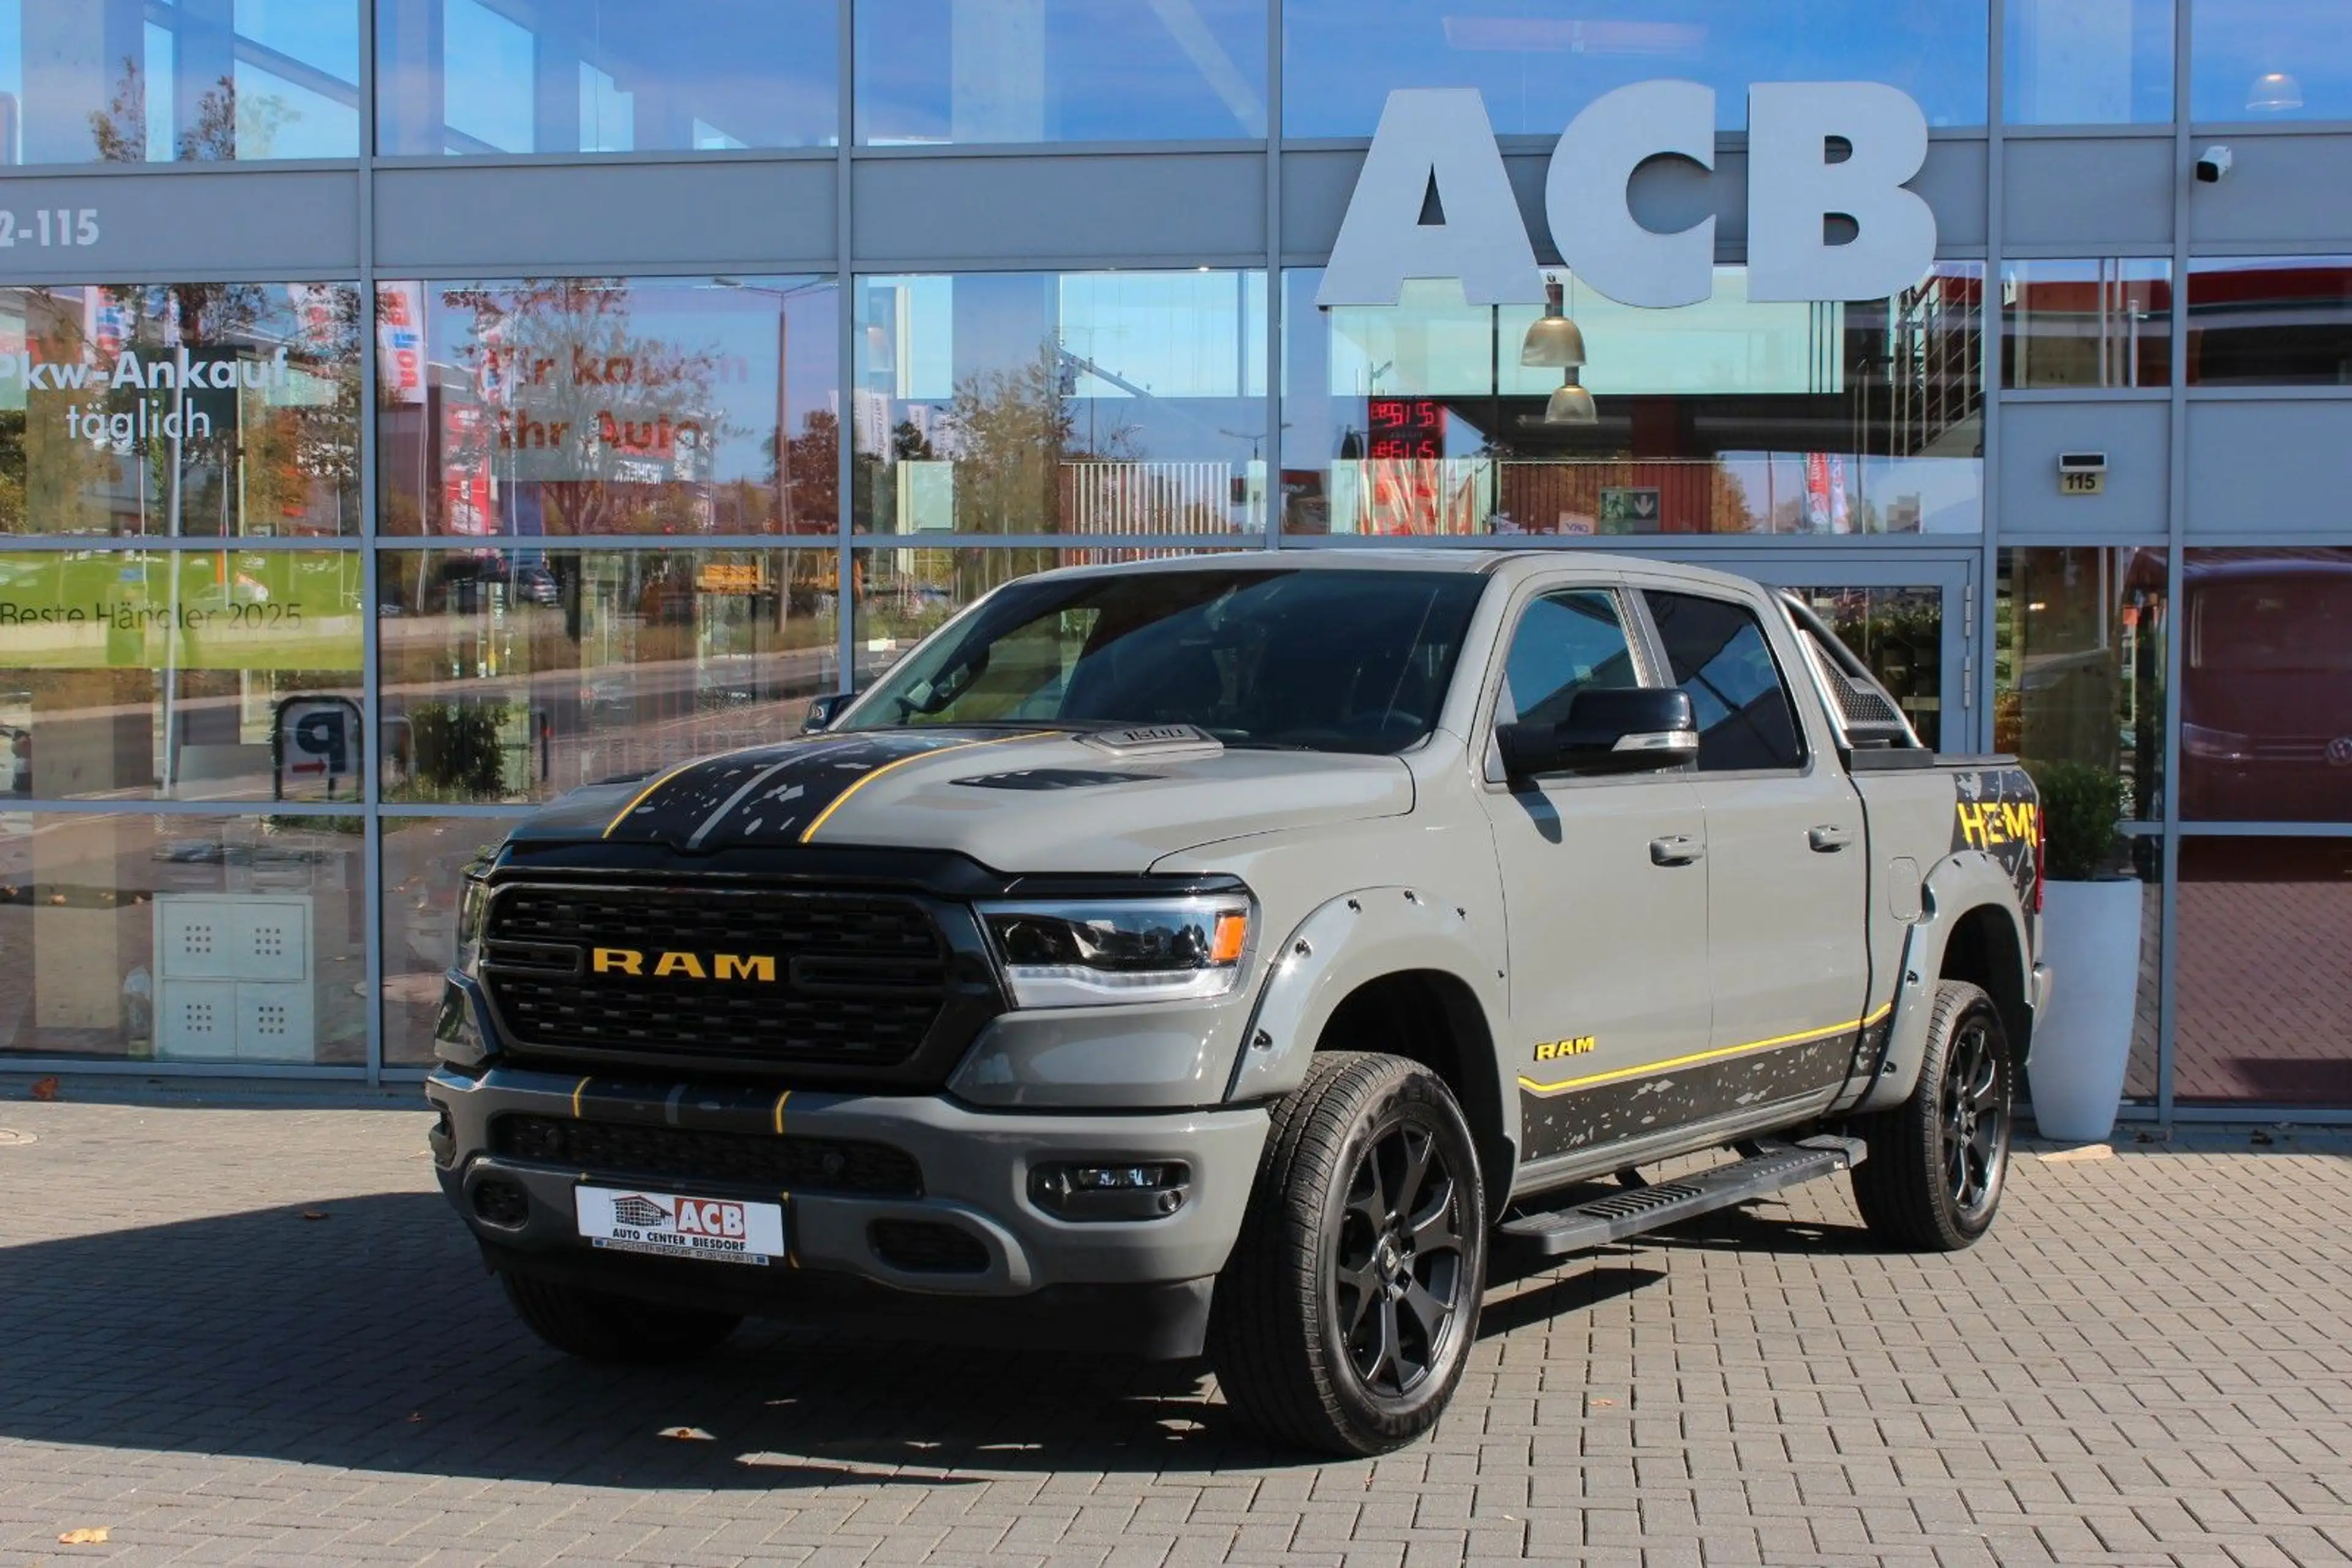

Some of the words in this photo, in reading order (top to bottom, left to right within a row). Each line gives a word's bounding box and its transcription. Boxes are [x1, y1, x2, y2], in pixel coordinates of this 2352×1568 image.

[1315, 79, 1937, 308] ACB
[66, 398, 210, 451] täglich
[2066, 473, 2096, 490] 115
[1, 603, 85, 628] Beste
[227, 603, 303, 630] 2025
[594, 948, 775, 981] RAM
[1533, 1035, 1594, 1061] RAM
[677, 1200, 745, 1236] ACB
[612, 1227, 640, 1240] AUTO
[647, 1232, 686, 1246] CENTER
[692, 1237, 745, 1251] BIESDORF
